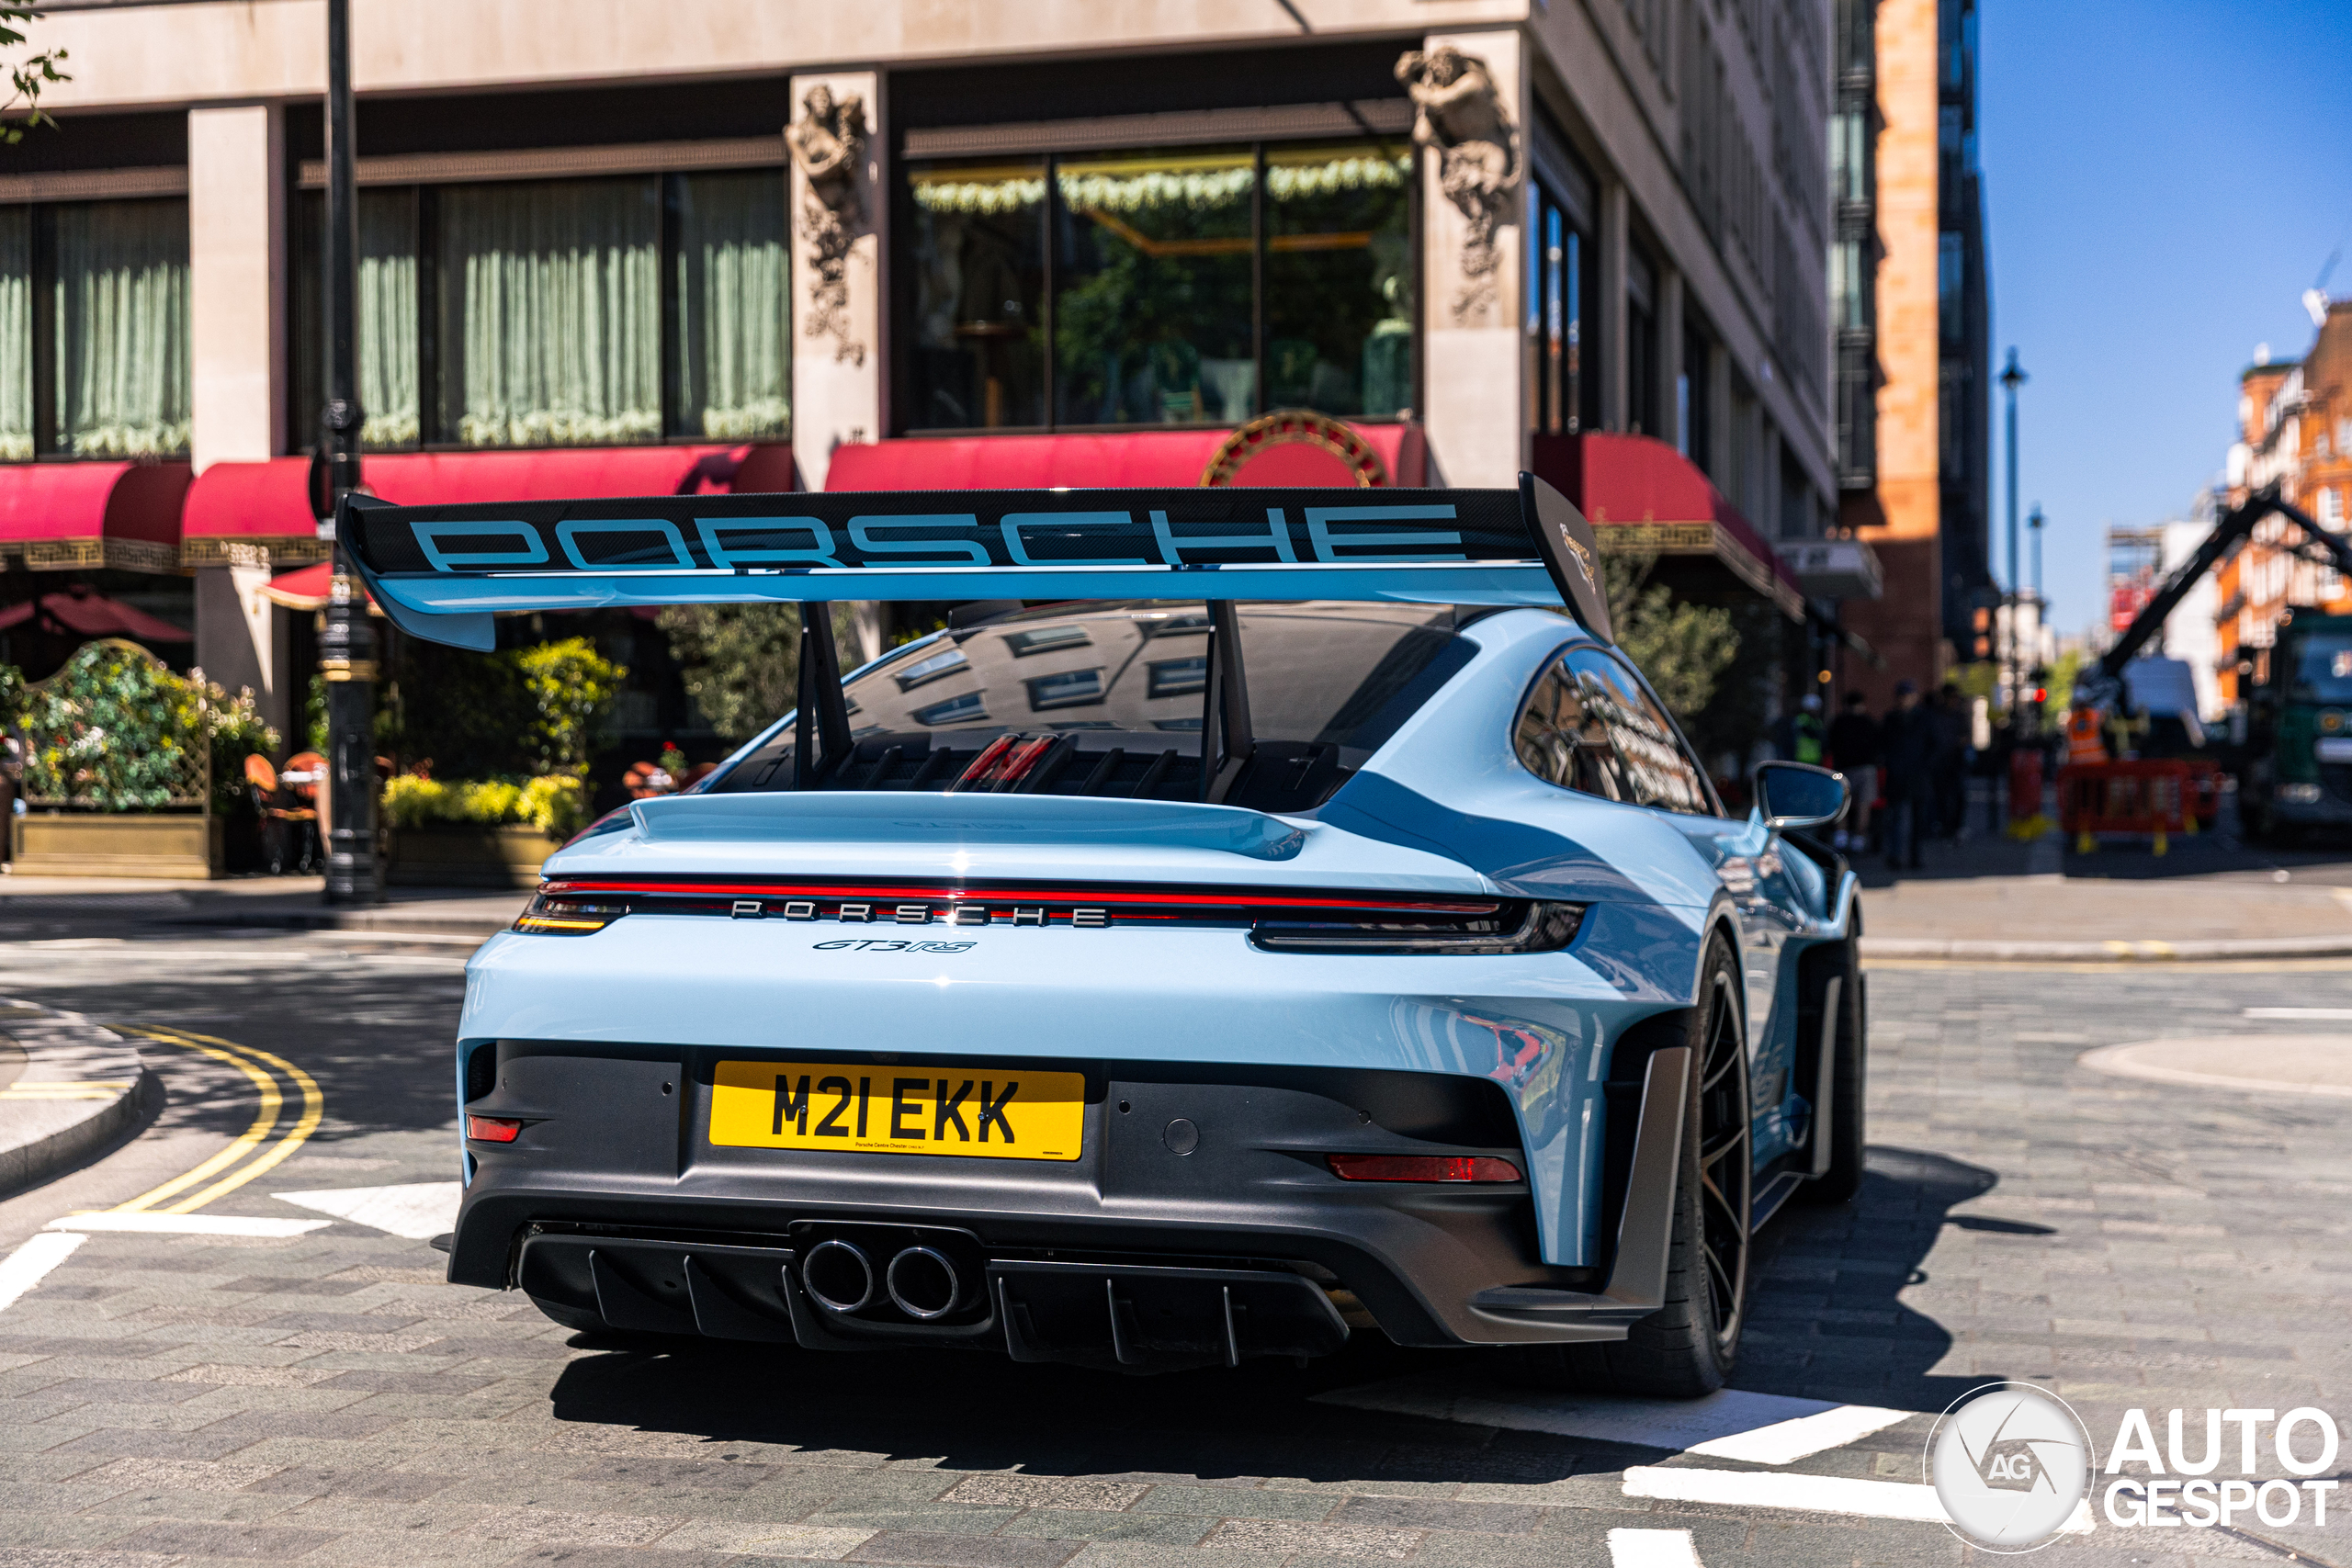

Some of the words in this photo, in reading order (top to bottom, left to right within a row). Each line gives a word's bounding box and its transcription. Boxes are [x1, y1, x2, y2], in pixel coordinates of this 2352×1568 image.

[409, 503, 1467, 572] PORSCHE
[731, 900, 1109, 928] PORSCHE
[771, 1074, 871, 1138] M21
[888, 1077, 1019, 1145] EKK
